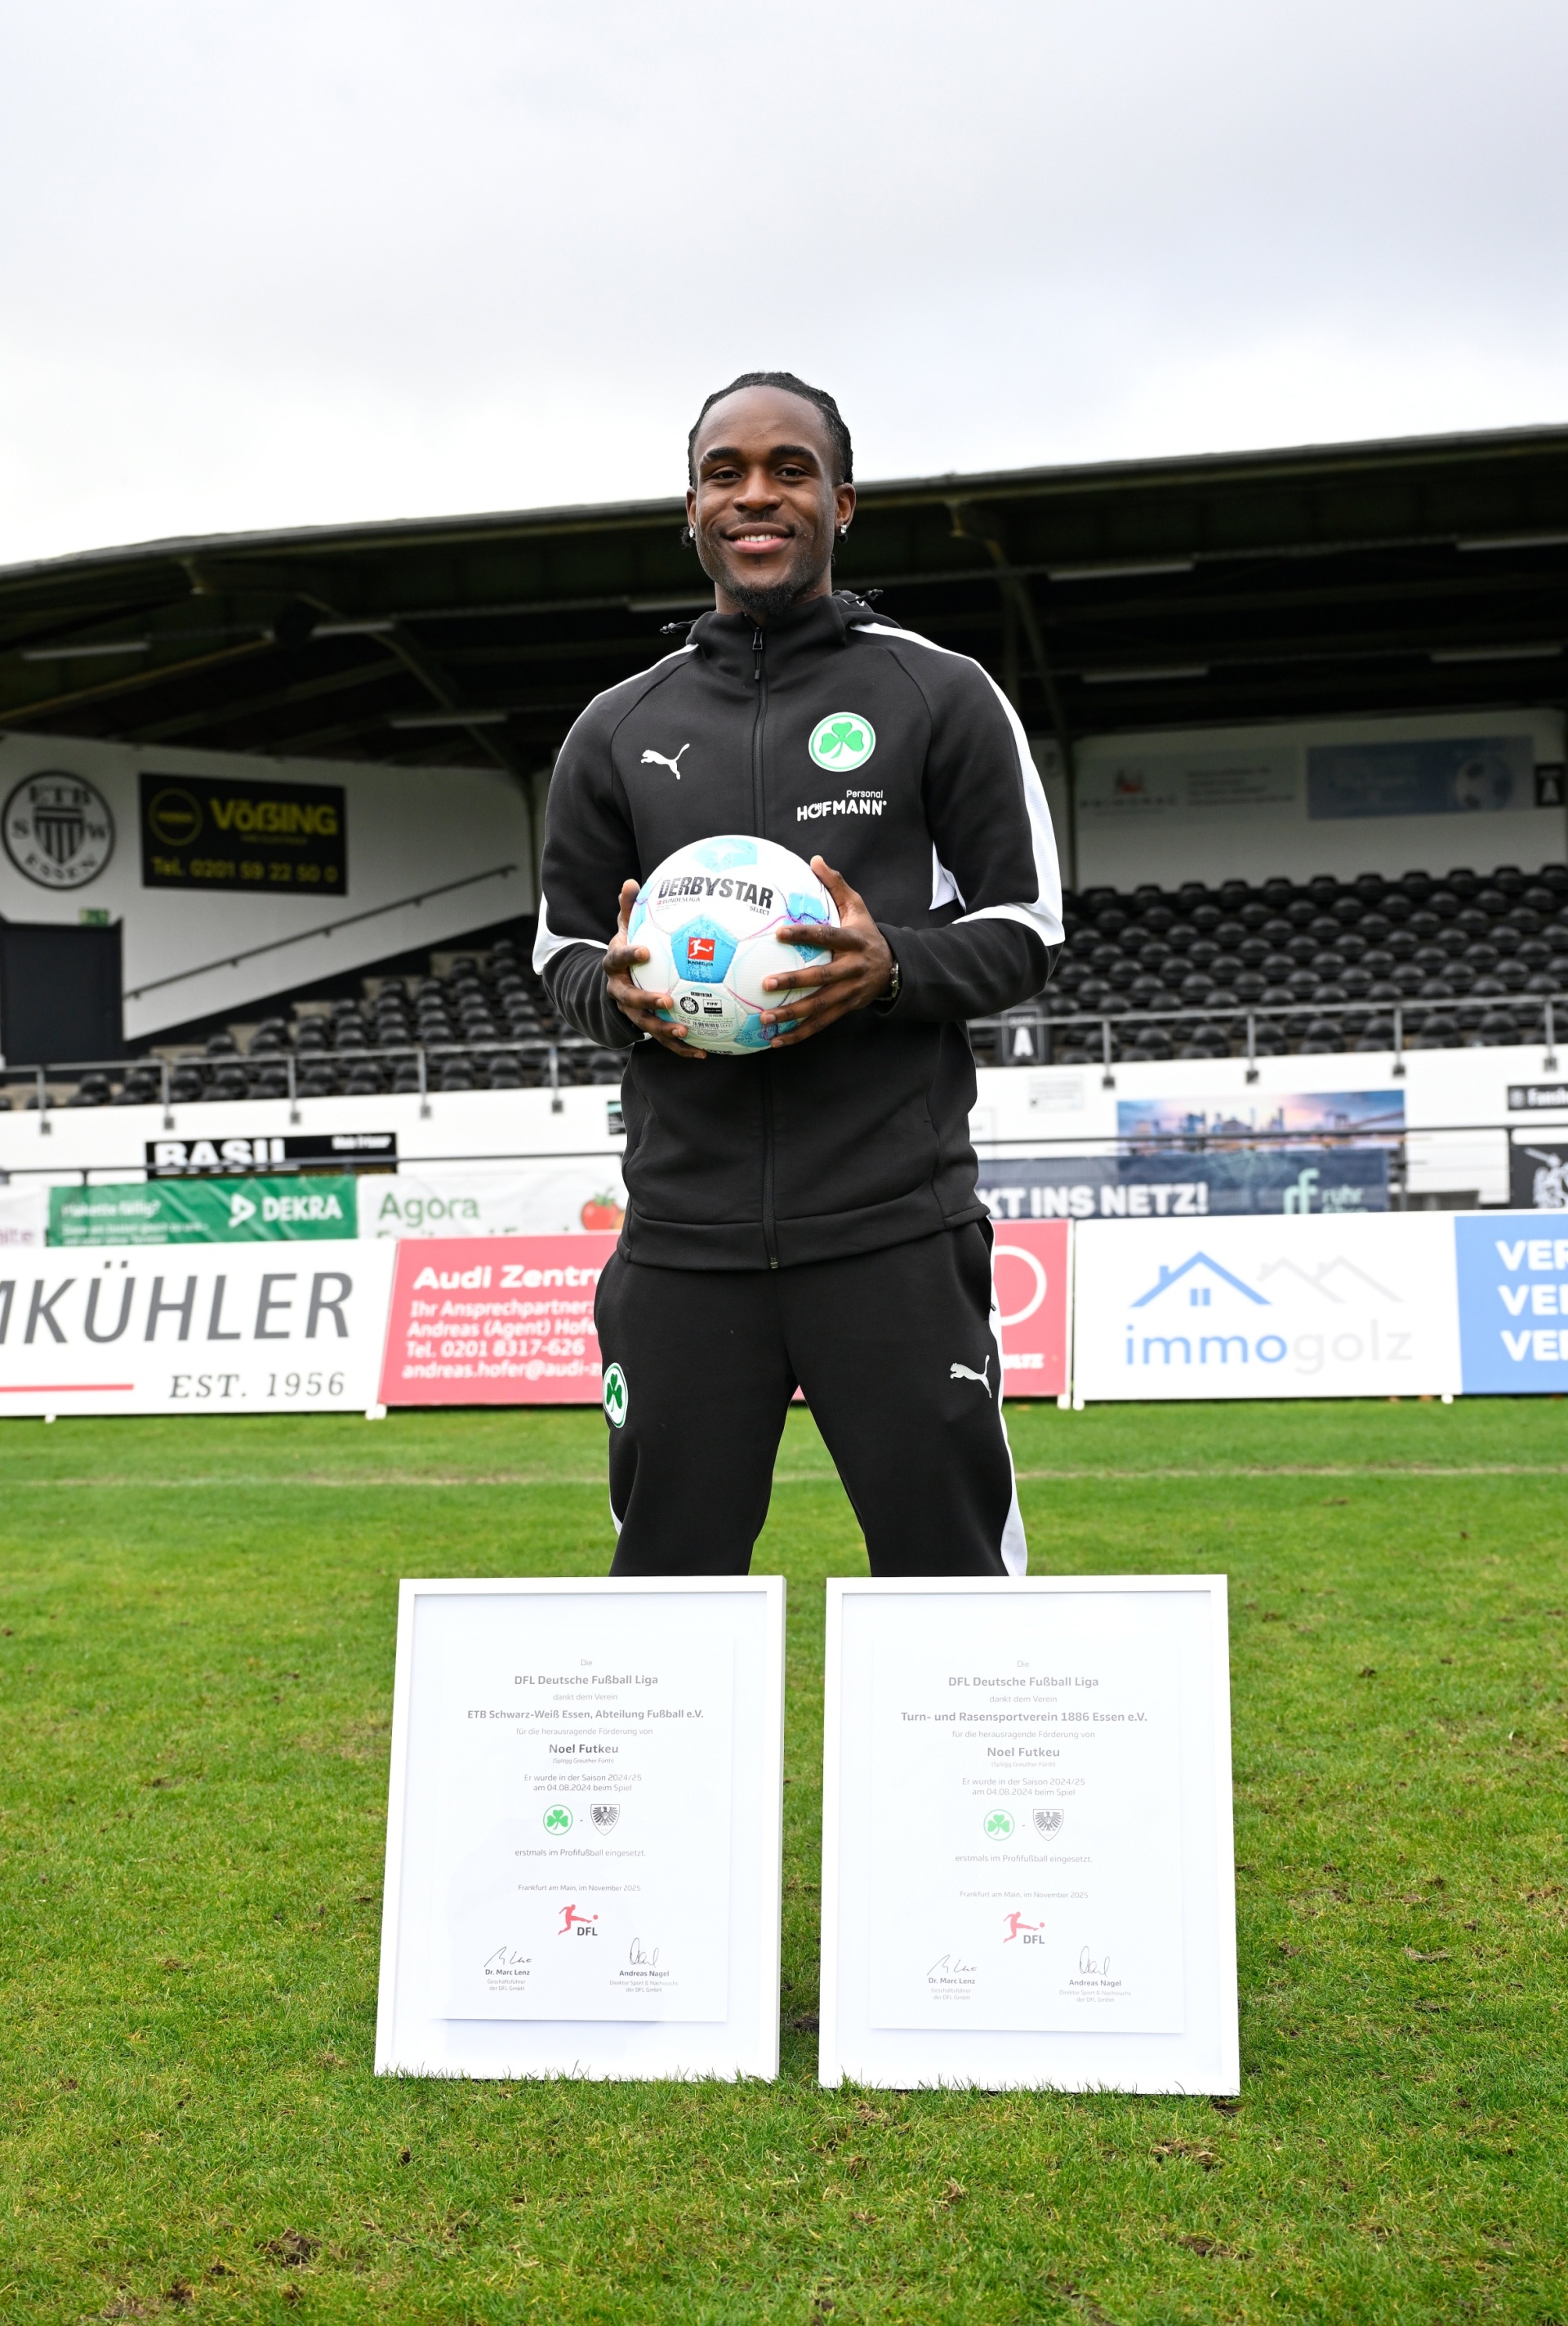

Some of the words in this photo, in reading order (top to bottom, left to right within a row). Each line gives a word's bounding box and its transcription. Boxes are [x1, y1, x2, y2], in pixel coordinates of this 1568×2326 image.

[29, 784, 91, 805] ETB
[846, 789, 884, 799] Personal
[152, 856, 185, 877] Tel.
[657, 876, 774, 910] DERBYSTAR
[662, 897, 701, 905] BUNDESLIGA
[749, 905, 770, 916] SELECT
[687, 959, 714, 967] BUNDESLIGA
[1013, 1027, 1034, 1056] A
[1030, 1185, 1095, 1218] INS
[1100, 1182, 1209, 1217] NETZ!
[261, 1195, 343, 1223] DEKRA
[378, 1192, 480, 1228] Agora
[412, 1266, 492, 1290] Audi
[0, 1260, 354, 1345] KÜHLER
[411, 1299, 437, 1317] Ihr
[408, 1320, 479, 1338] Andreas
[483, 1318, 550, 1339] (Agent)
[406, 1342, 435, 1359] Tel.
[441, 1340, 488, 1358] 0201
[493, 1339, 586, 1357] 8317-626
[1125, 1318, 1413, 1375] immogolz
[402, 1359, 603, 1381] andreas.hofer@audi-z
[169, 1374, 247, 1399] EST.
[266, 1371, 345, 1397] 1956
[580, 1659, 593, 1667] Die
[1017, 1660, 1030, 1669] Die
[514, 1675, 536, 1685] DFL
[537, 1674, 589, 1685] Deutsche
[591, 1674, 632, 1685] Fußball
[635, 1674, 658, 1687] Liga
[948, 1677, 971, 1687] DFL
[973, 1676, 1027, 1687] Deutsche
[1029, 1676, 1071, 1687] Fußball
[1075, 1676, 1099, 1689] Liga
[552, 1693, 575, 1701] dankt
[575, 1693, 593, 1701] dem
[594, 1693, 618, 1701] Verein
[989, 1695, 1012, 1703] dankt
[1013, 1695, 1031, 1703] dem
[1032, 1695, 1058, 1703] Verein
[467, 1709, 487, 1719] ETB
[488, 1709, 560, 1719] Schwarz-Weiß
[562, 1709, 594, 1720] Essen,
[595, 1709, 645, 1721] Abteilung
[647, 1709, 684, 1718] Fußball
[686, 1709, 704, 1718] e.V.
[900, 1712, 932, 1722] Turn-
[933, 1711, 956, 1722] und
[959, 1711, 1058, 1724] Rasensportverein
[1061, 1712, 1090, 1722] 1886
[1092, 1712, 1125, 1722] Essen
[1127, 1712, 1147, 1722] e.V.
[516, 1727, 528, 1736] für
[528, 1727, 540, 1736] die
[541, 1727, 598, 1737] herausragende
[598, 1727, 638, 1737] Förderung
[951, 1730, 964, 1738] für
[964, 1730, 978, 1738] die
[978, 1730, 1037, 1740] herausragende
[1038, 1730, 1080, 1740] Förderung
[549, 1744, 576, 1754] Noel
[578, 1744, 619, 1753] Futkeu
[987, 1746, 1015, 1758] Noel
[1018, 1746, 1060, 1758] Futkeu
[523, 1773, 532, 1781] Er
[533, 1773, 558, 1781] wurde
[567, 1773, 581, 1781] der
[581, 1773, 607, 1781] Saison
[608, 1773, 642, 1781] 2024/25
[961, 1777, 971, 1785] Er
[971, 1777, 997, 1785] wurde
[998, 1777, 1006, 1785] in
[1007, 1777, 1022, 1786] der
[1022, 1777, 1049, 1786] Saison
[1049, 1777, 1086, 1786] 2024/25
[546, 1784, 591, 1792] 04.08.2024
[592, 1784, 612, 1792] beim
[613, 1784, 632, 1794] Spiel
[986, 1787, 1033, 1796] 04.08.2024
[1034, 1788, 1055, 1796] beim
[1056, 1788, 1076, 1798] Spiel
[514, 1848, 547, 1856] erstmals
[548, 1848, 559, 1856] im
[559, 1848, 604, 1856] Profifußball
[604, 1849, 646, 1859] eingesetzt.
[955, 1853, 989, 1862] erstmals
[990, 1854, 1001, 1862] im
[1002, 1854, 1049, 1863] Profifußball
[1049, 1855, 1094, 1865] eingesetzt.
[518, 1883, 547, 1892] Frankfurt
[559, 1884, 578, 1892] Main,
[959, 1890, 991, 1898] Frankfurt
[1004, 1891, 1022, 1899] Main,
[1033, 1891, 1069, 1899] November
[1070, 1891, 1089, 1899] 2025
[577, 1927, 599, 1936] DFL
[1022, 1934, 1045, 1945] DFL
[648, 1970, 670, 1979] Nagel
[928, 1976, 938, 1985] Dr.
[1100, 1979, 1122, 1988] Nagel
